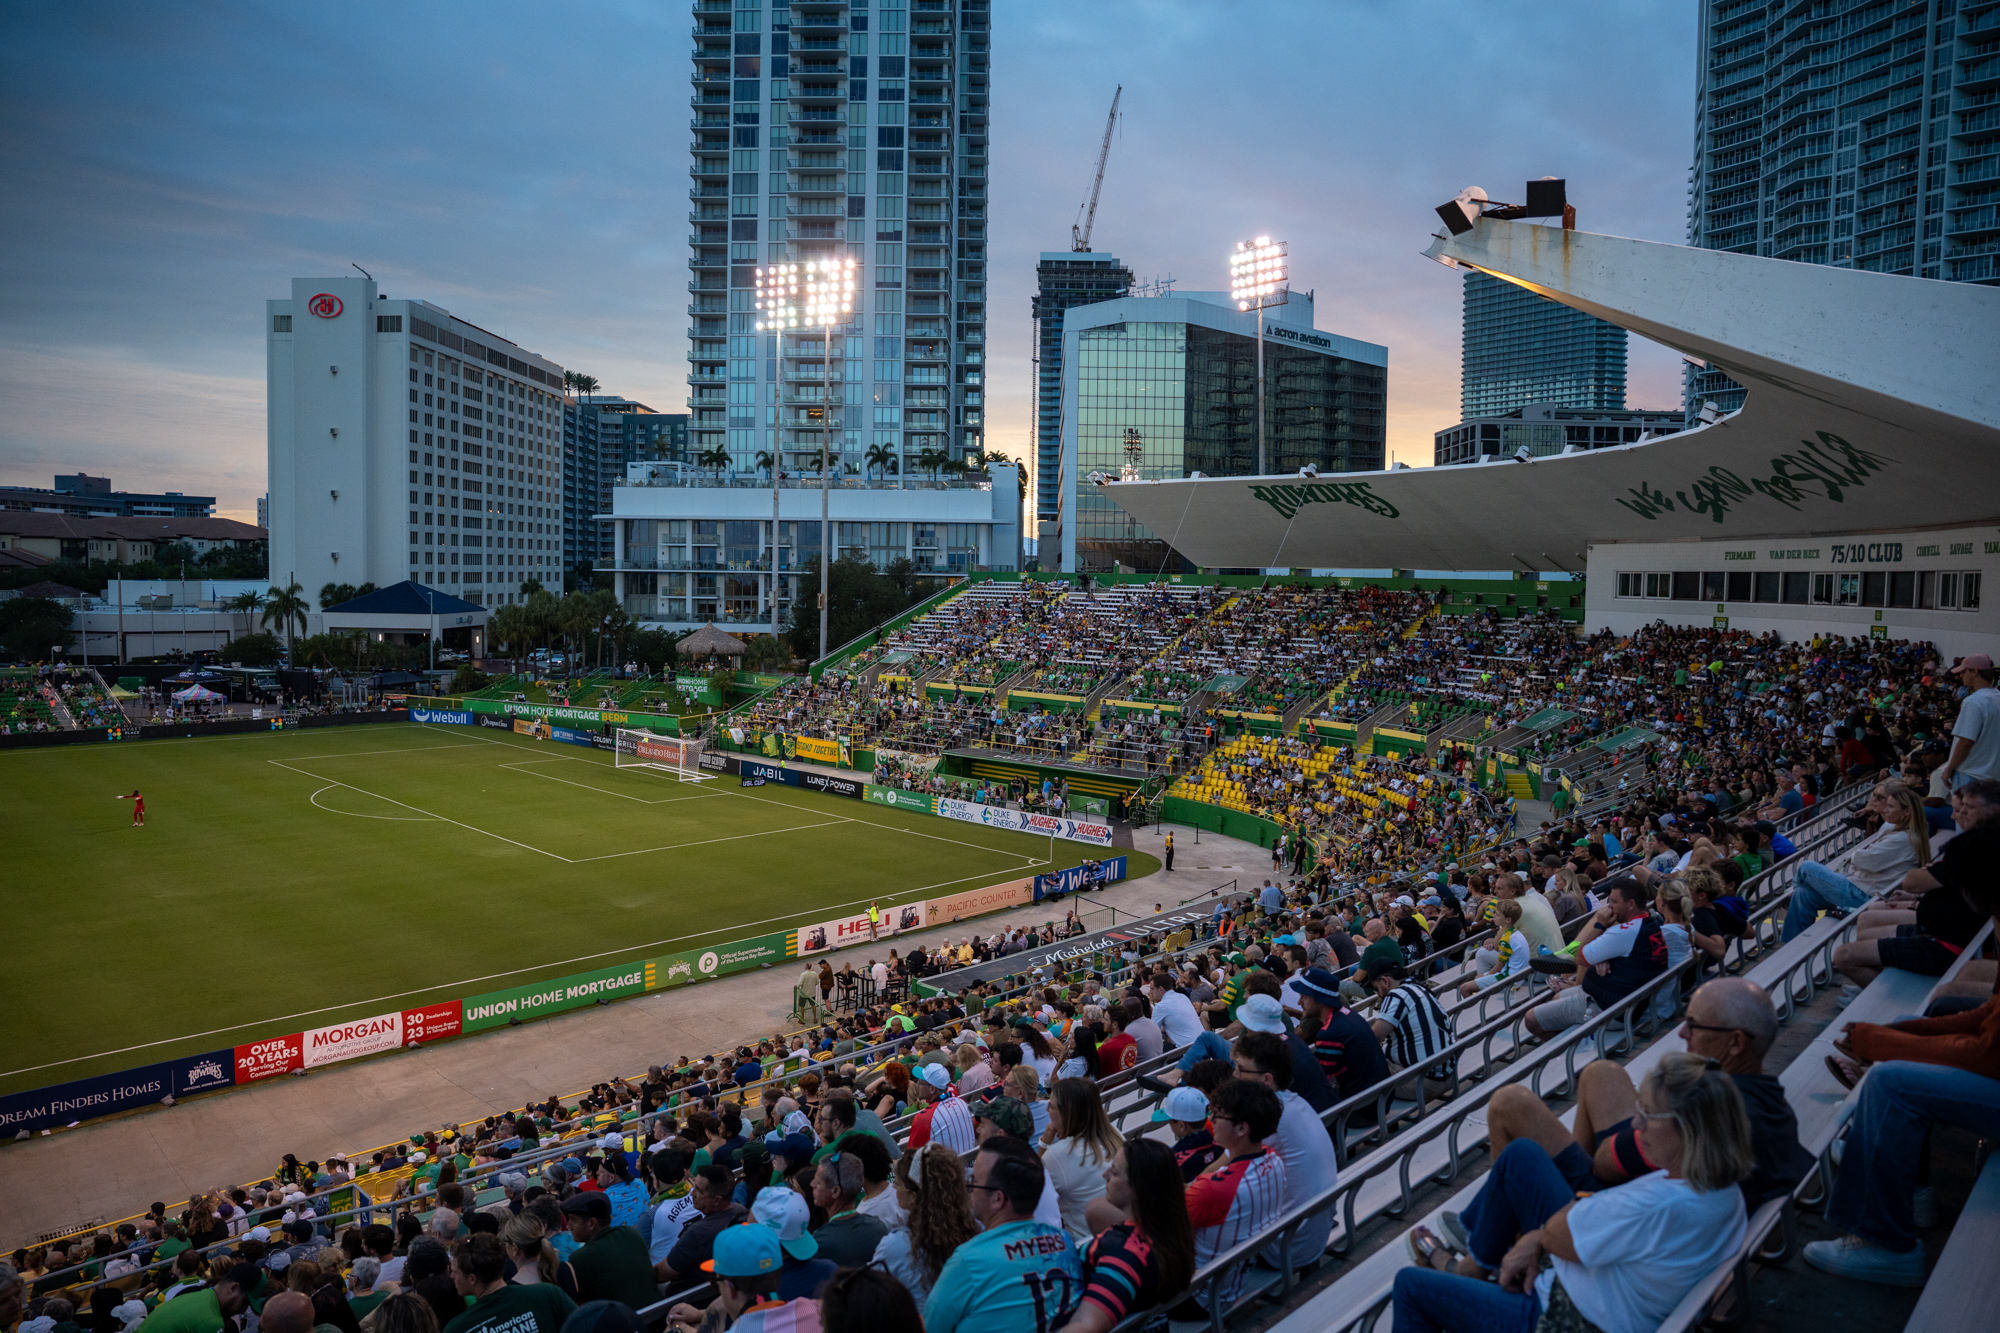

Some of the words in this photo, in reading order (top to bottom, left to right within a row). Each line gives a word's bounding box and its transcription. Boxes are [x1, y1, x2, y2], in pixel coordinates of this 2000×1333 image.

[1274, 327, 1298, 340] acron
[1300, 333, 1330, 348] aviation
[1248, 482, 1400, 519] ROWDIES
[1724, 550, 1756, 560] FIRMANI
[1770, 550, 1785, 560] VAN
[1786, 550, 1802, 559] DER
[1803, 549, 1820, 559] BECK
[1831, 543, 1865, 563] 75/10
[1868, 543, 1903, 563] CLUB
[1950, 543, 1973, 555] SAVAGE
[431, 712, 466, 724] Webull
[504, 704, 529, 714] UNION
[531, 706, 553, 716] HOME
[555, 709, 600, 720] MORTGAGE
[601, 712, 628, 723] BERM
[637, 745, 663, 757] ORLANDO
[753, 766, 785, 781] JABIL
[951, 801, 966, 811] DUKE
[950, 809, 974, 821] ENERGY
[994, 810, 1010, 819] DUKE
[1029, 815, 1057, 828] HUGHES
[993, 818, 1018, 829] ENERGY
[1076, 823, 1106, 837] HUGHES
[947, 897, 979, 913] PACIFIC
[980, 889, 1017, 907] COUNTER
[1028, 938, 1114, 967] Michelob
[1124, 910, 1209, 936] ULTRA
[720, 951, 737, 960] Official
[738, 946, 766, 956] Supermarket
[467, 999, 517, 1020] UNION
[521, 990, 563, 1010] HOME
[566, 972, 641, 999] MORTGAGE
[406, 1013, 424, 1025] 30
[426, 1010, 452, 1020] Dealerships
[312, 1018, 394, 1048] MORGAN
[406, 1026, 424, 1038] 23
[250, 1040, 286, 1055] OVER
[312, 1040, 394, 1063] MORGANAUTOGROUP.COM
[326, 1041, 361, 1052] AUTOMOTIVE
[362, 1036, 381, 1045] GROUP
[238, 1056, 257, 1068] 20
[258, 1046, 298, 1064] YEARS
[249, 1063, 274, 1073] Serving
[275, 1059, 289, 1067] Our
[250, 1066, 288, 1078] Community
[50, 1092, 109, 1115] FINDERS
[112, 1080, 161, 1102] HOMES
[1004, 1234, 1066, 1261] MYERS
[1022, 1267, 1077, 1333] 12
